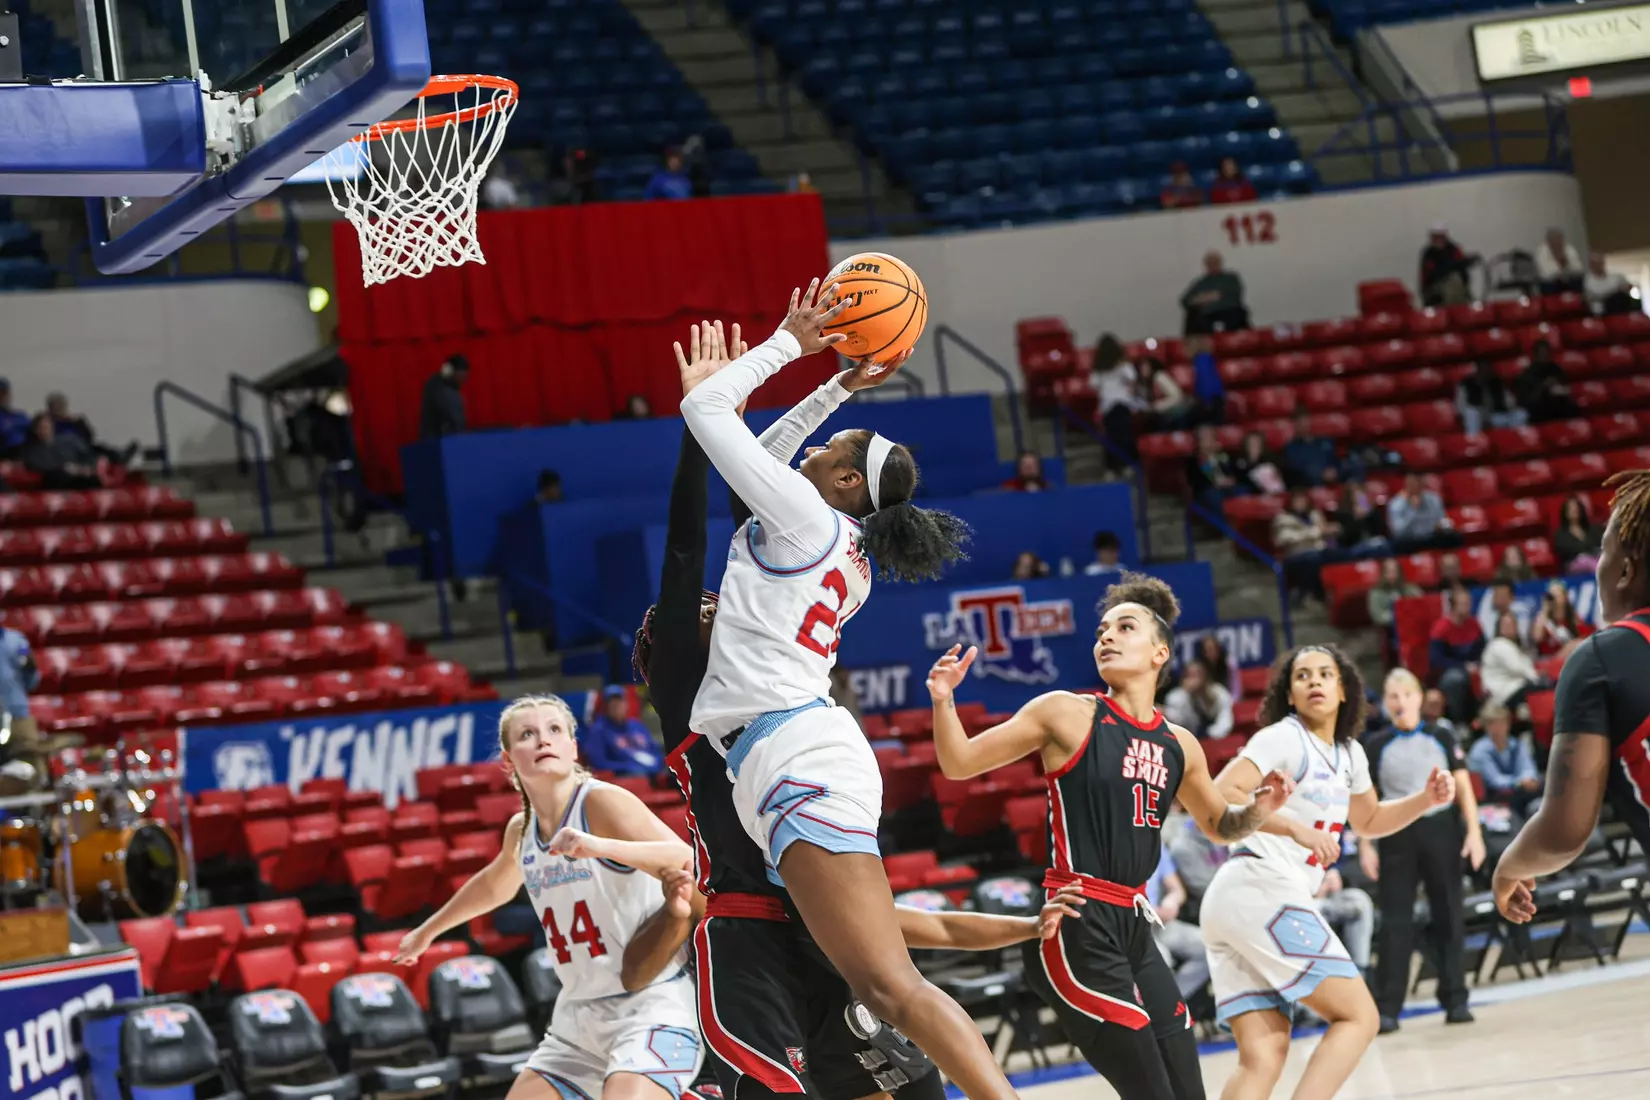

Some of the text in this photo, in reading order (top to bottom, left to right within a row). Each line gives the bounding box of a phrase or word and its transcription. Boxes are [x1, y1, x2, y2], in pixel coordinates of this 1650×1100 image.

[1222, 211, 1279, 246] 112
[1127, 738, 1165, 766] JAX
[1122, 755, 1168, 789] STATE
[1132, 783, 1161, 828] 15
